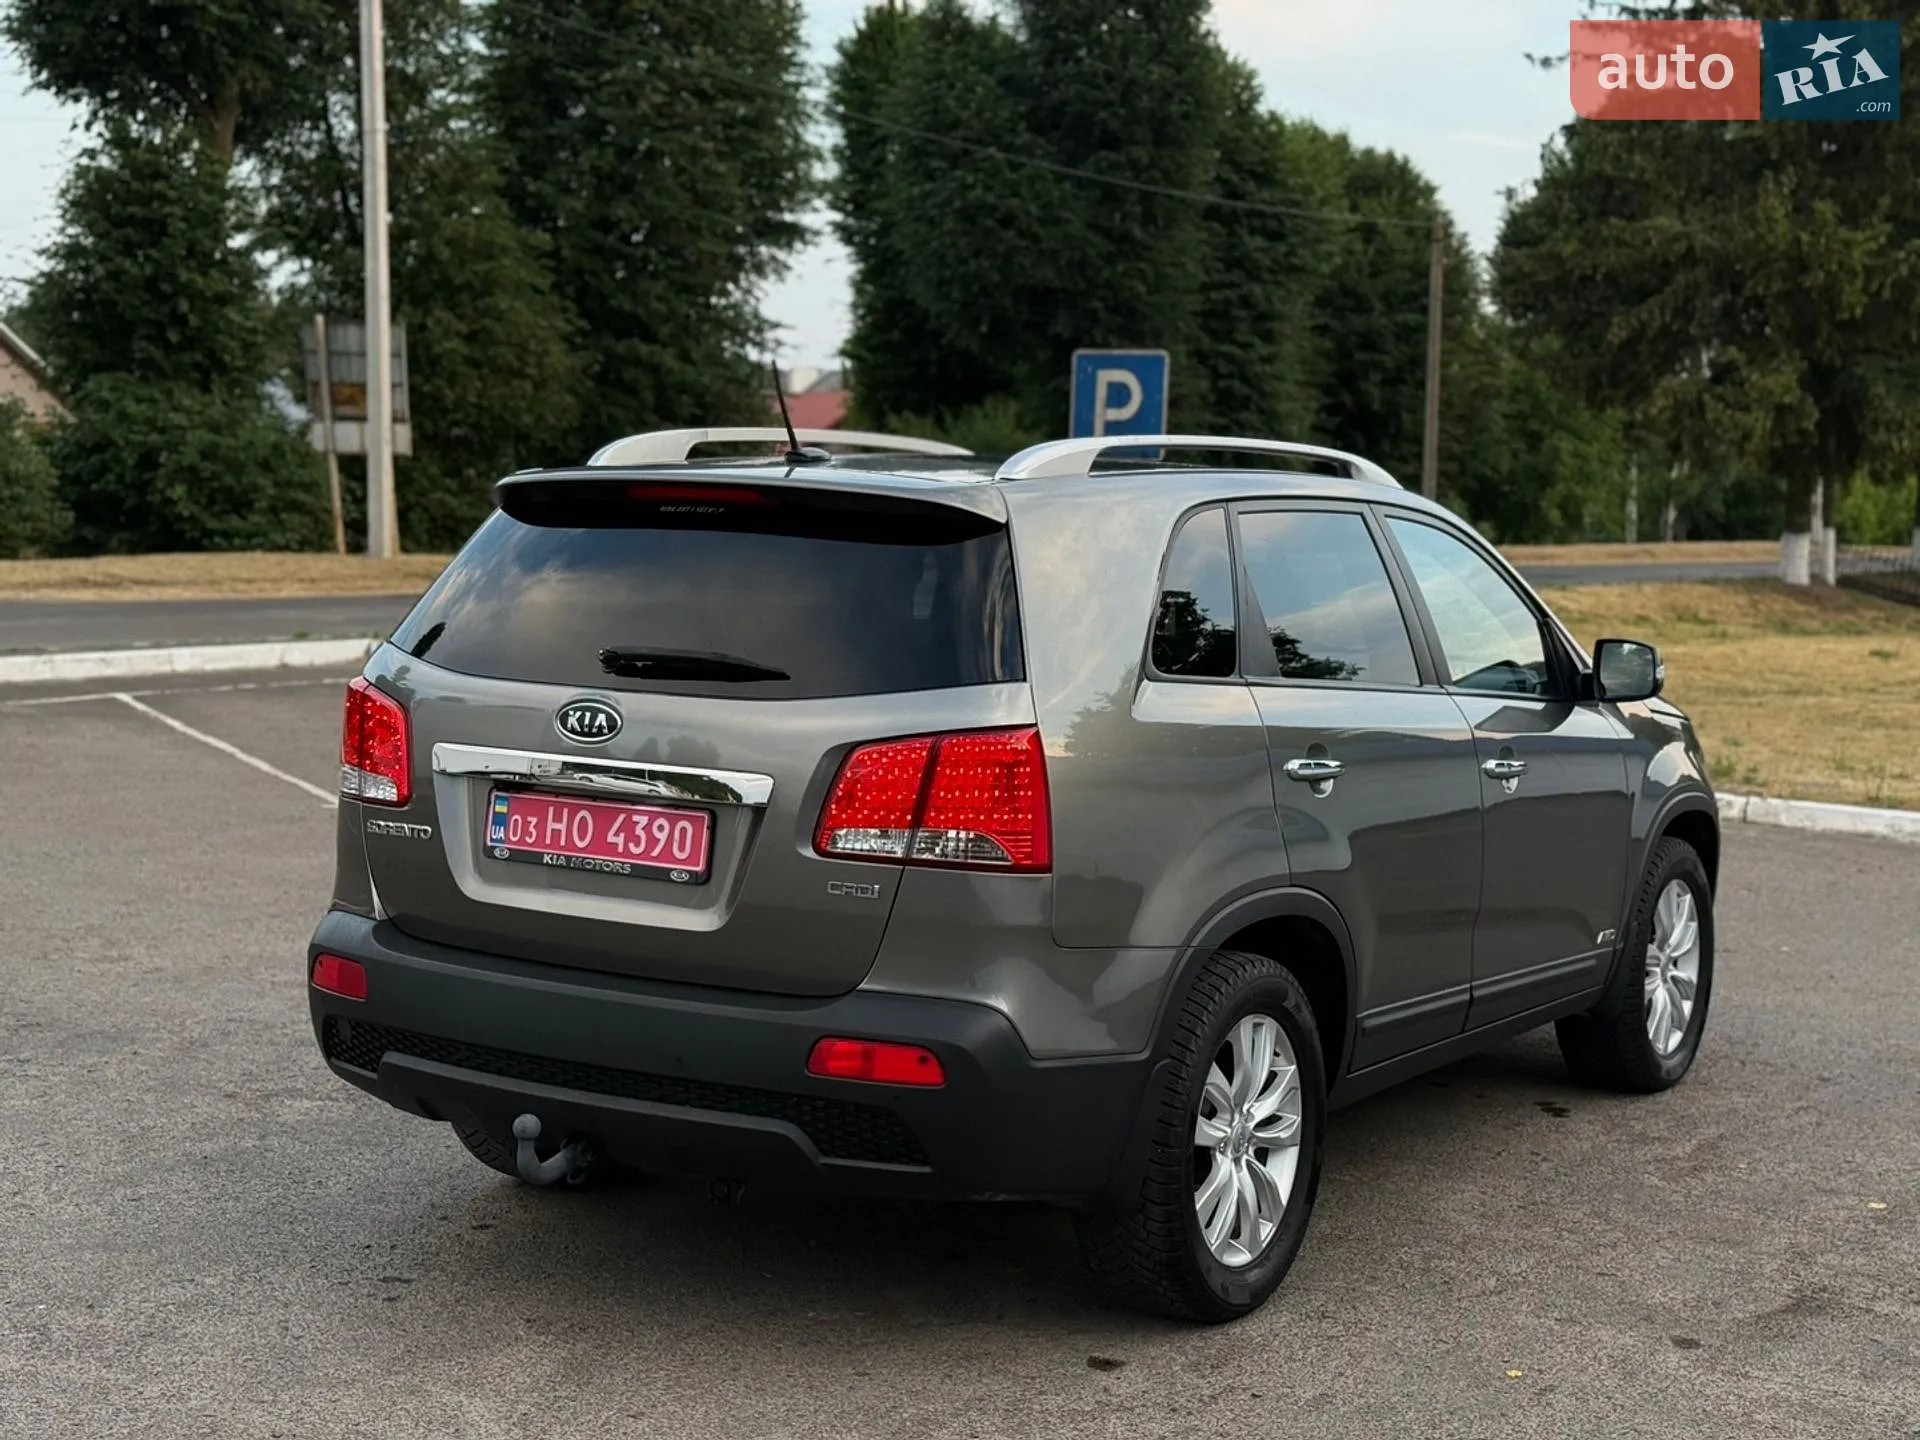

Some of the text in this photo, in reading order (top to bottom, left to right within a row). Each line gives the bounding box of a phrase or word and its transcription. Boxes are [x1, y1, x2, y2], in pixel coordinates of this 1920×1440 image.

[1093, 369, 1143, 437] P
[566, 710, 609, 734] KIA
[367, 819, 433, 840] SORENTO
[491, 806, 694, 861] UA 03 HO 4390
[543, 853, 632, 874] KIA MOTORS
